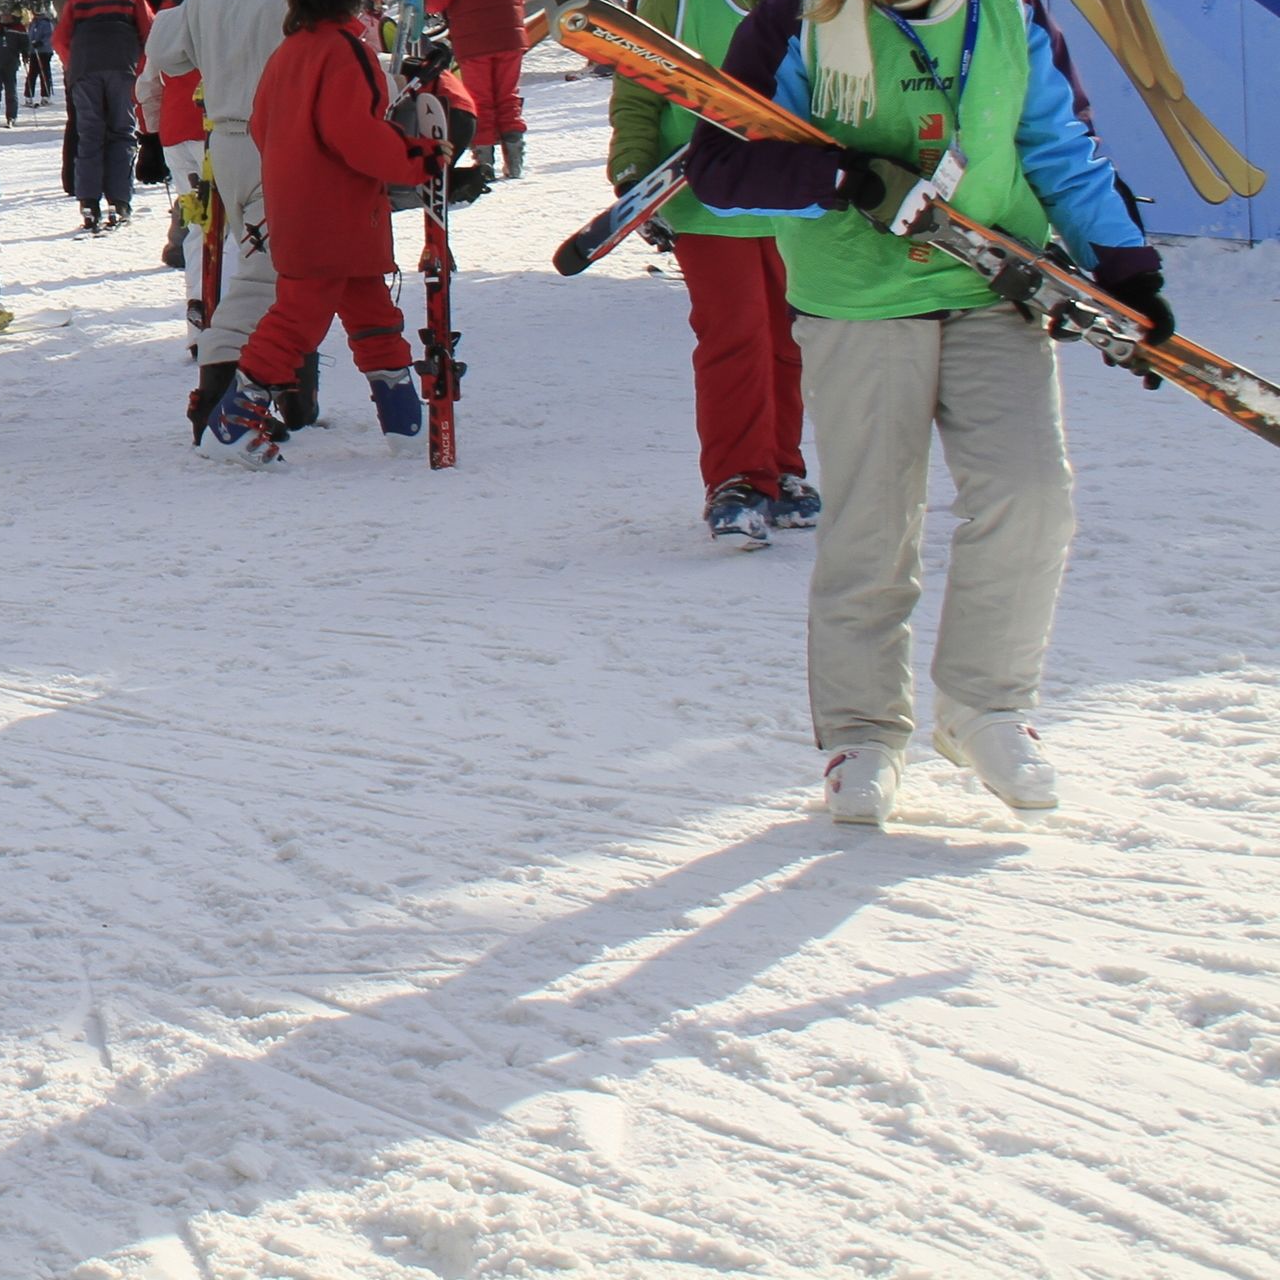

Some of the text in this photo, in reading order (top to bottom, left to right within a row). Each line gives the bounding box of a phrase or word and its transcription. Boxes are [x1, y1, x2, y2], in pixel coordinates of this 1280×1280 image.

[592, 27, 681, 73] DYNASTAR
[900, 76, 956, 93] virma
[431, 124, 445, 223] ATOC
